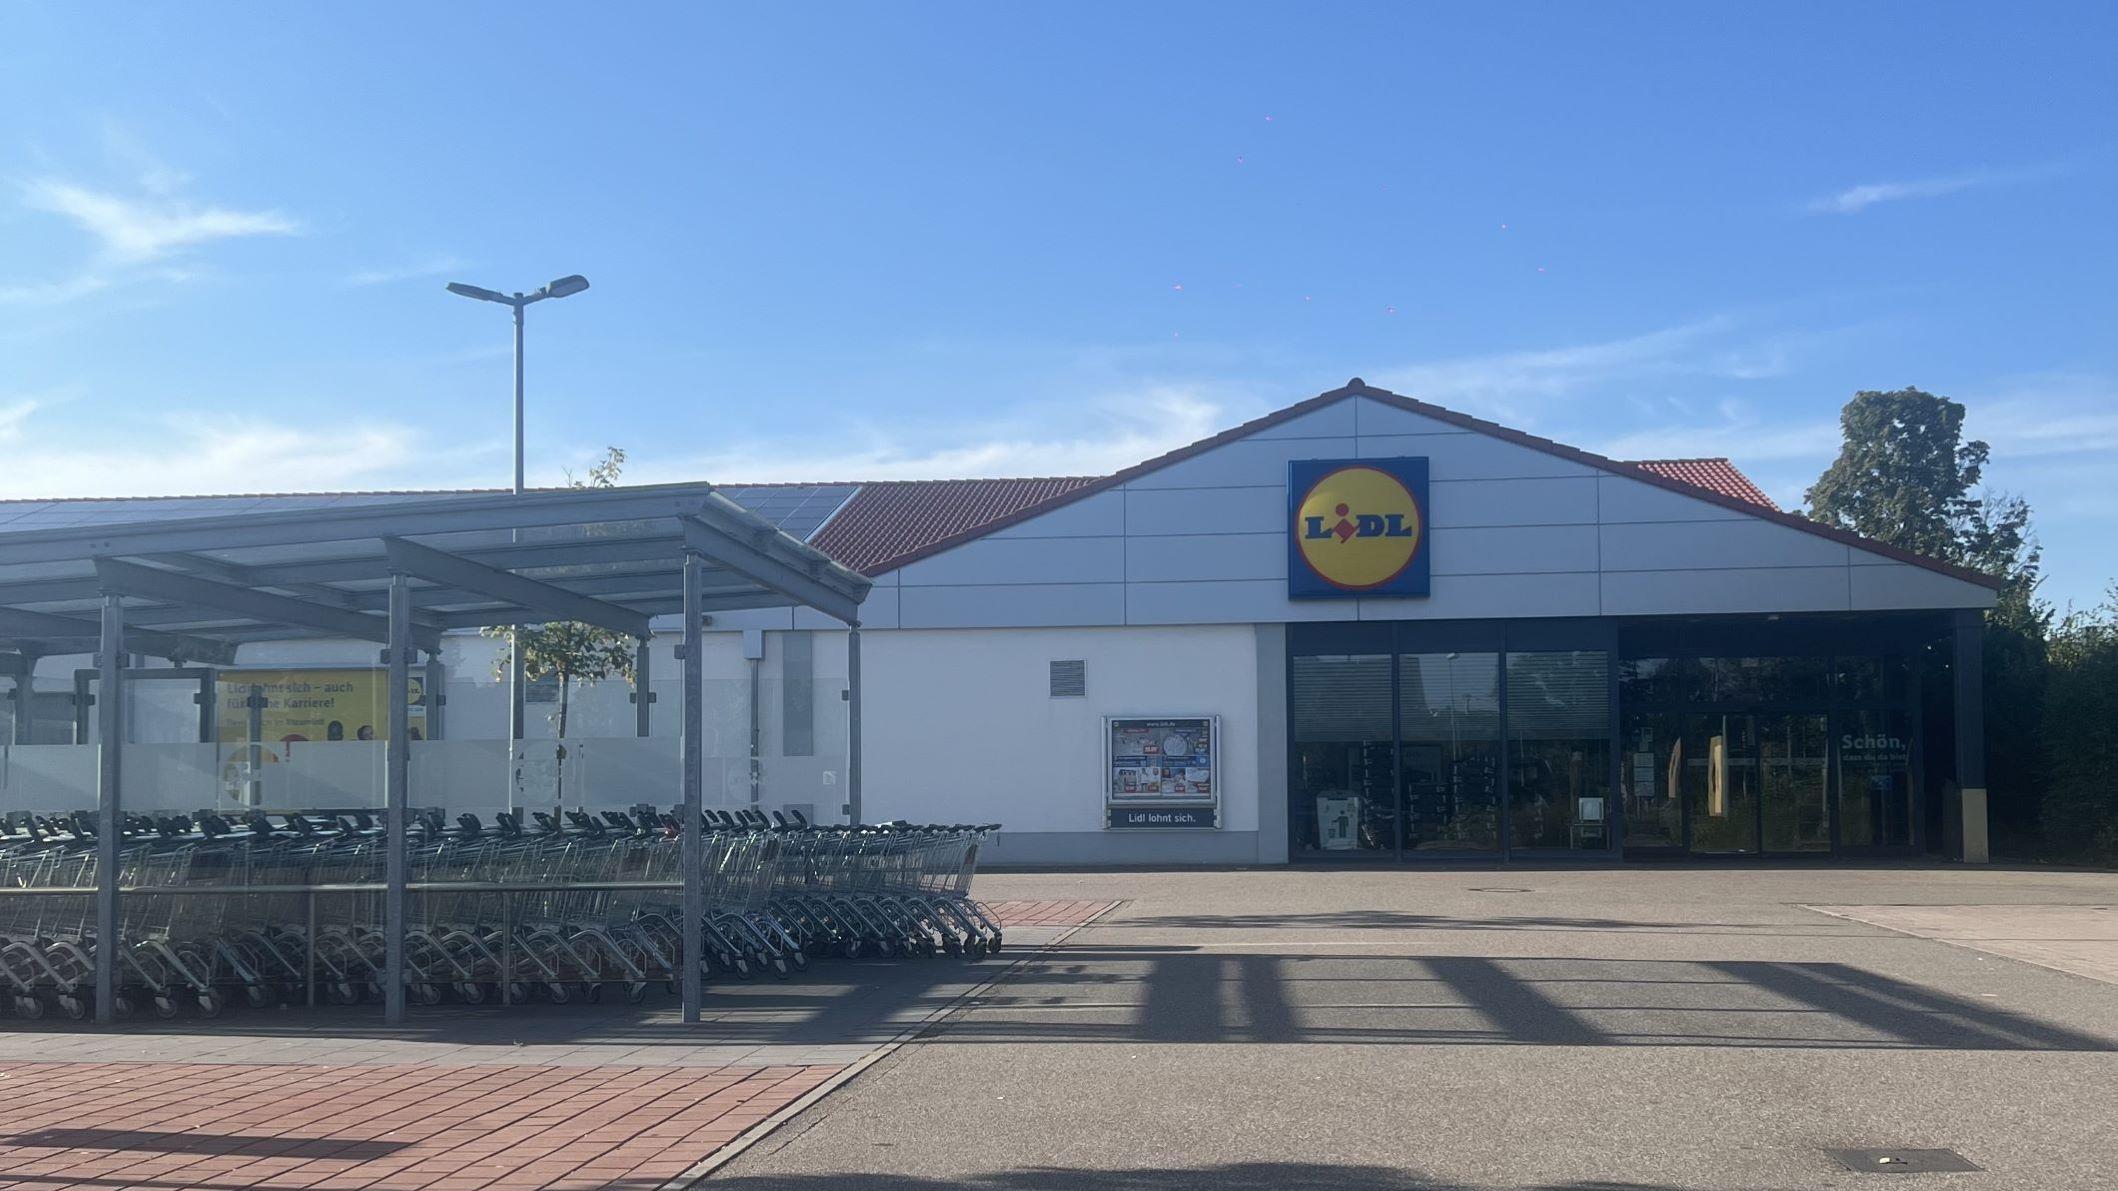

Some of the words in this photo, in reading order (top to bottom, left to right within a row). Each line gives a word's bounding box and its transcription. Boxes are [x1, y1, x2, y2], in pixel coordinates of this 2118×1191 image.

[325, 682, 354, 693] auch
[284, 697, 334, 708] Karriere!
[1842, 734, 1906, 751] Schön,
[1129, 813, 1145, 822] Lidl
[1149, 813, 1171, 822] lohnt
[1175, 813, 1196, 822] sich.
